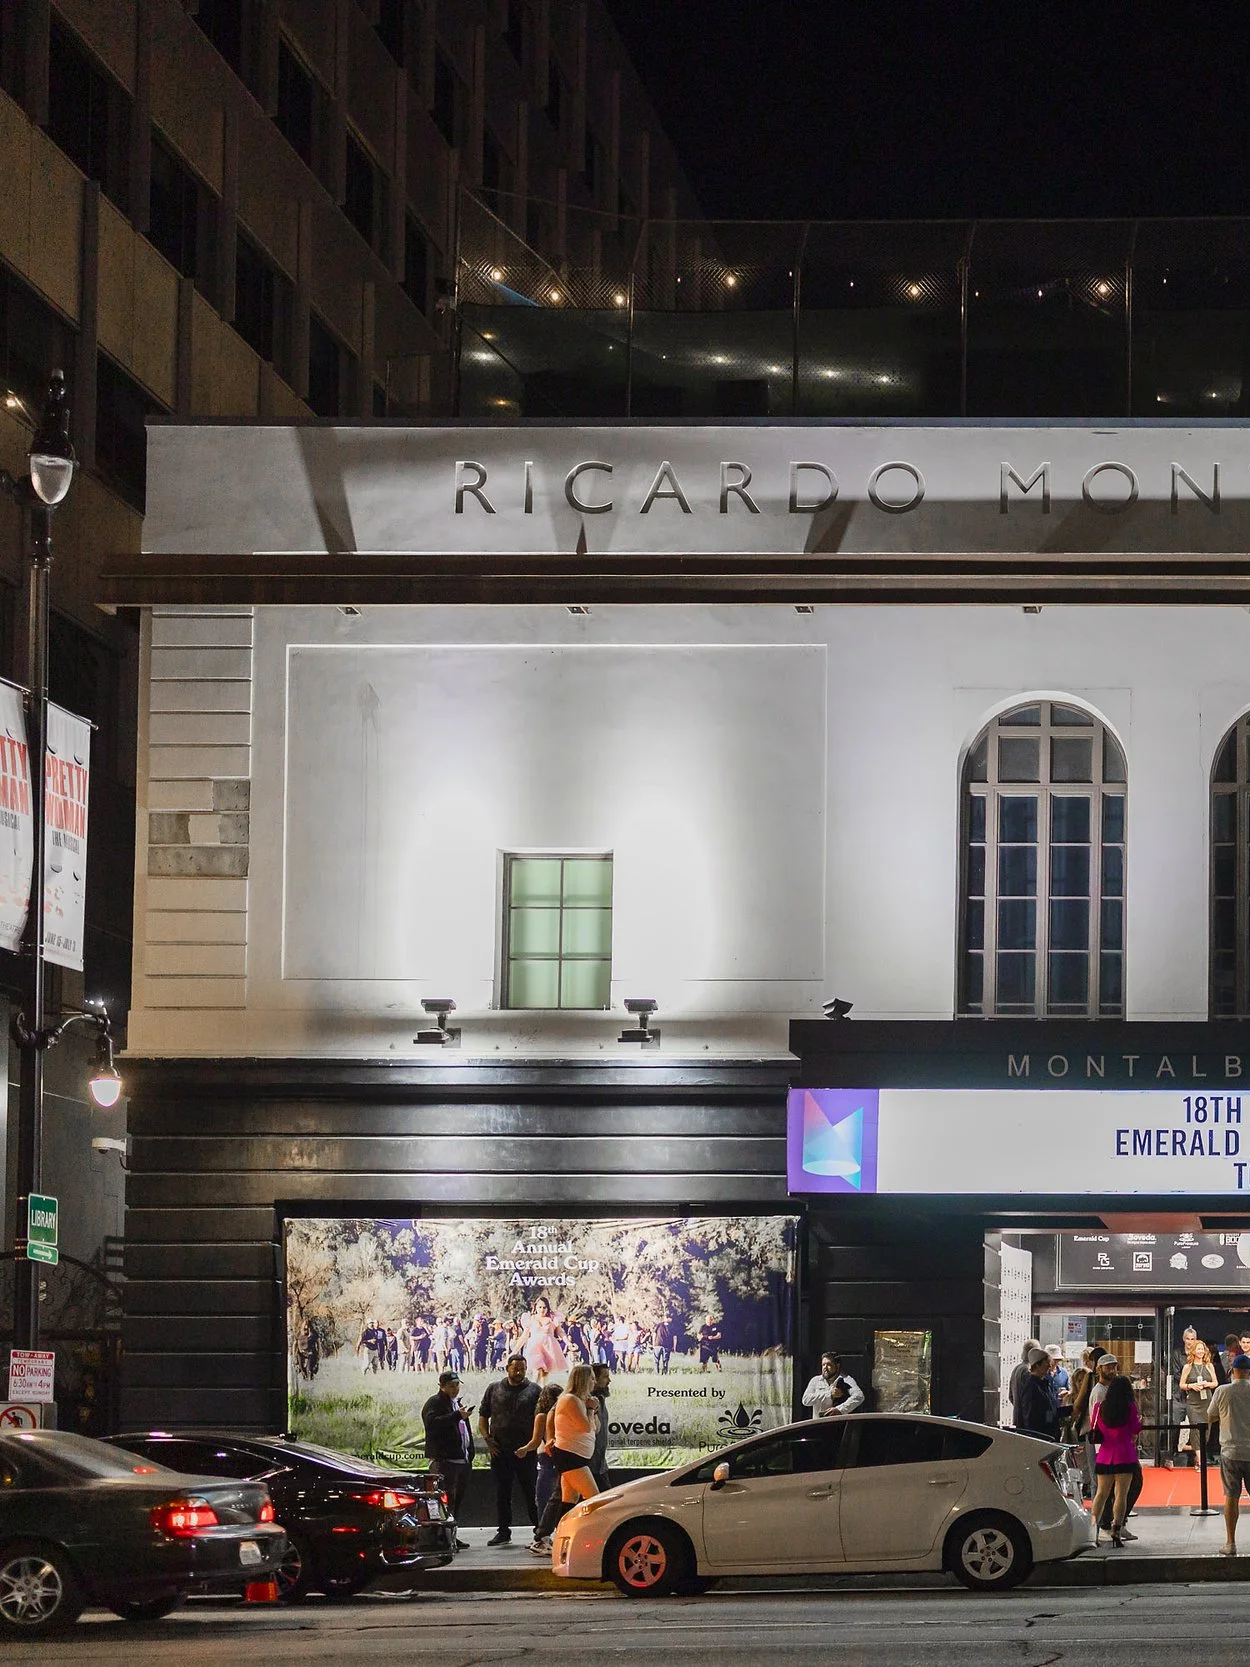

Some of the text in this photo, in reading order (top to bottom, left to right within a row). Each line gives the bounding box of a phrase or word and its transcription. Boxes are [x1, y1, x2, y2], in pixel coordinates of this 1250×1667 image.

[455, 461, 926, 514] RICARDO
[45, 752, 88, 805] PRETTY
[45, 793, 85, 839] WOMAN
[52, 830, 62, 847] THE
[1182, 1096, 1242, 1123] 18TH
[1115, 1129, 1240, 1156] EMERALD
[31, 1209, 56, 1229] LIBRARY
[529, 1226, 558, 1239] 18th
[511, 1240, 573, 1253] Annual
[485, 1255, 599, 1272] Emerald Cup
[509, 1272, 577, 1286] Awards
[13, 1364, 51, 1377] NO PARKING
[648, 1387, 726, 1399] Presented by
[608, 1416, 672, 1434] oveda
